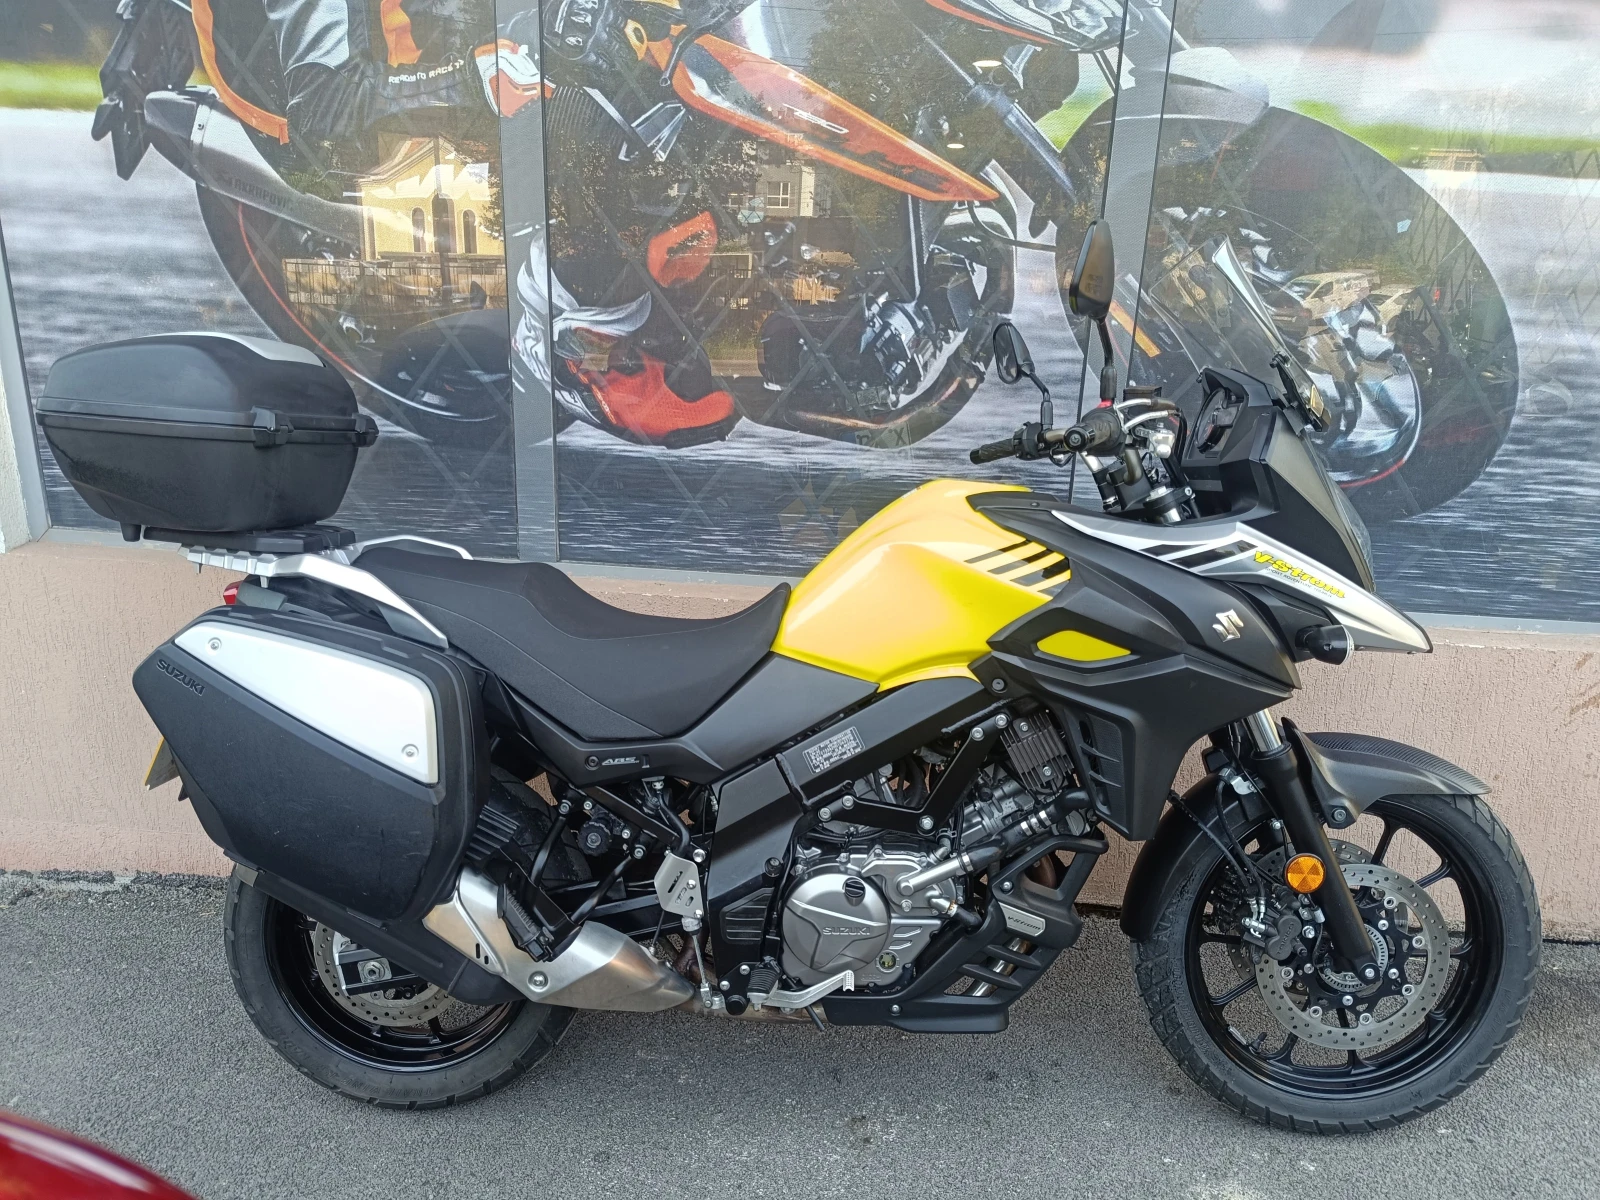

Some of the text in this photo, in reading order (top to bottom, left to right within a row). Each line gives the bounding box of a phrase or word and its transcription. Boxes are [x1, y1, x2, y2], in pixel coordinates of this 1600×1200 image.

[1253, 551, 1345, 598] V-Strom
[156, 658, 206, 697] SUZUKI
[601, 756, 637, 766] ABS
[822, 926, 871, 936] SUZUKI
